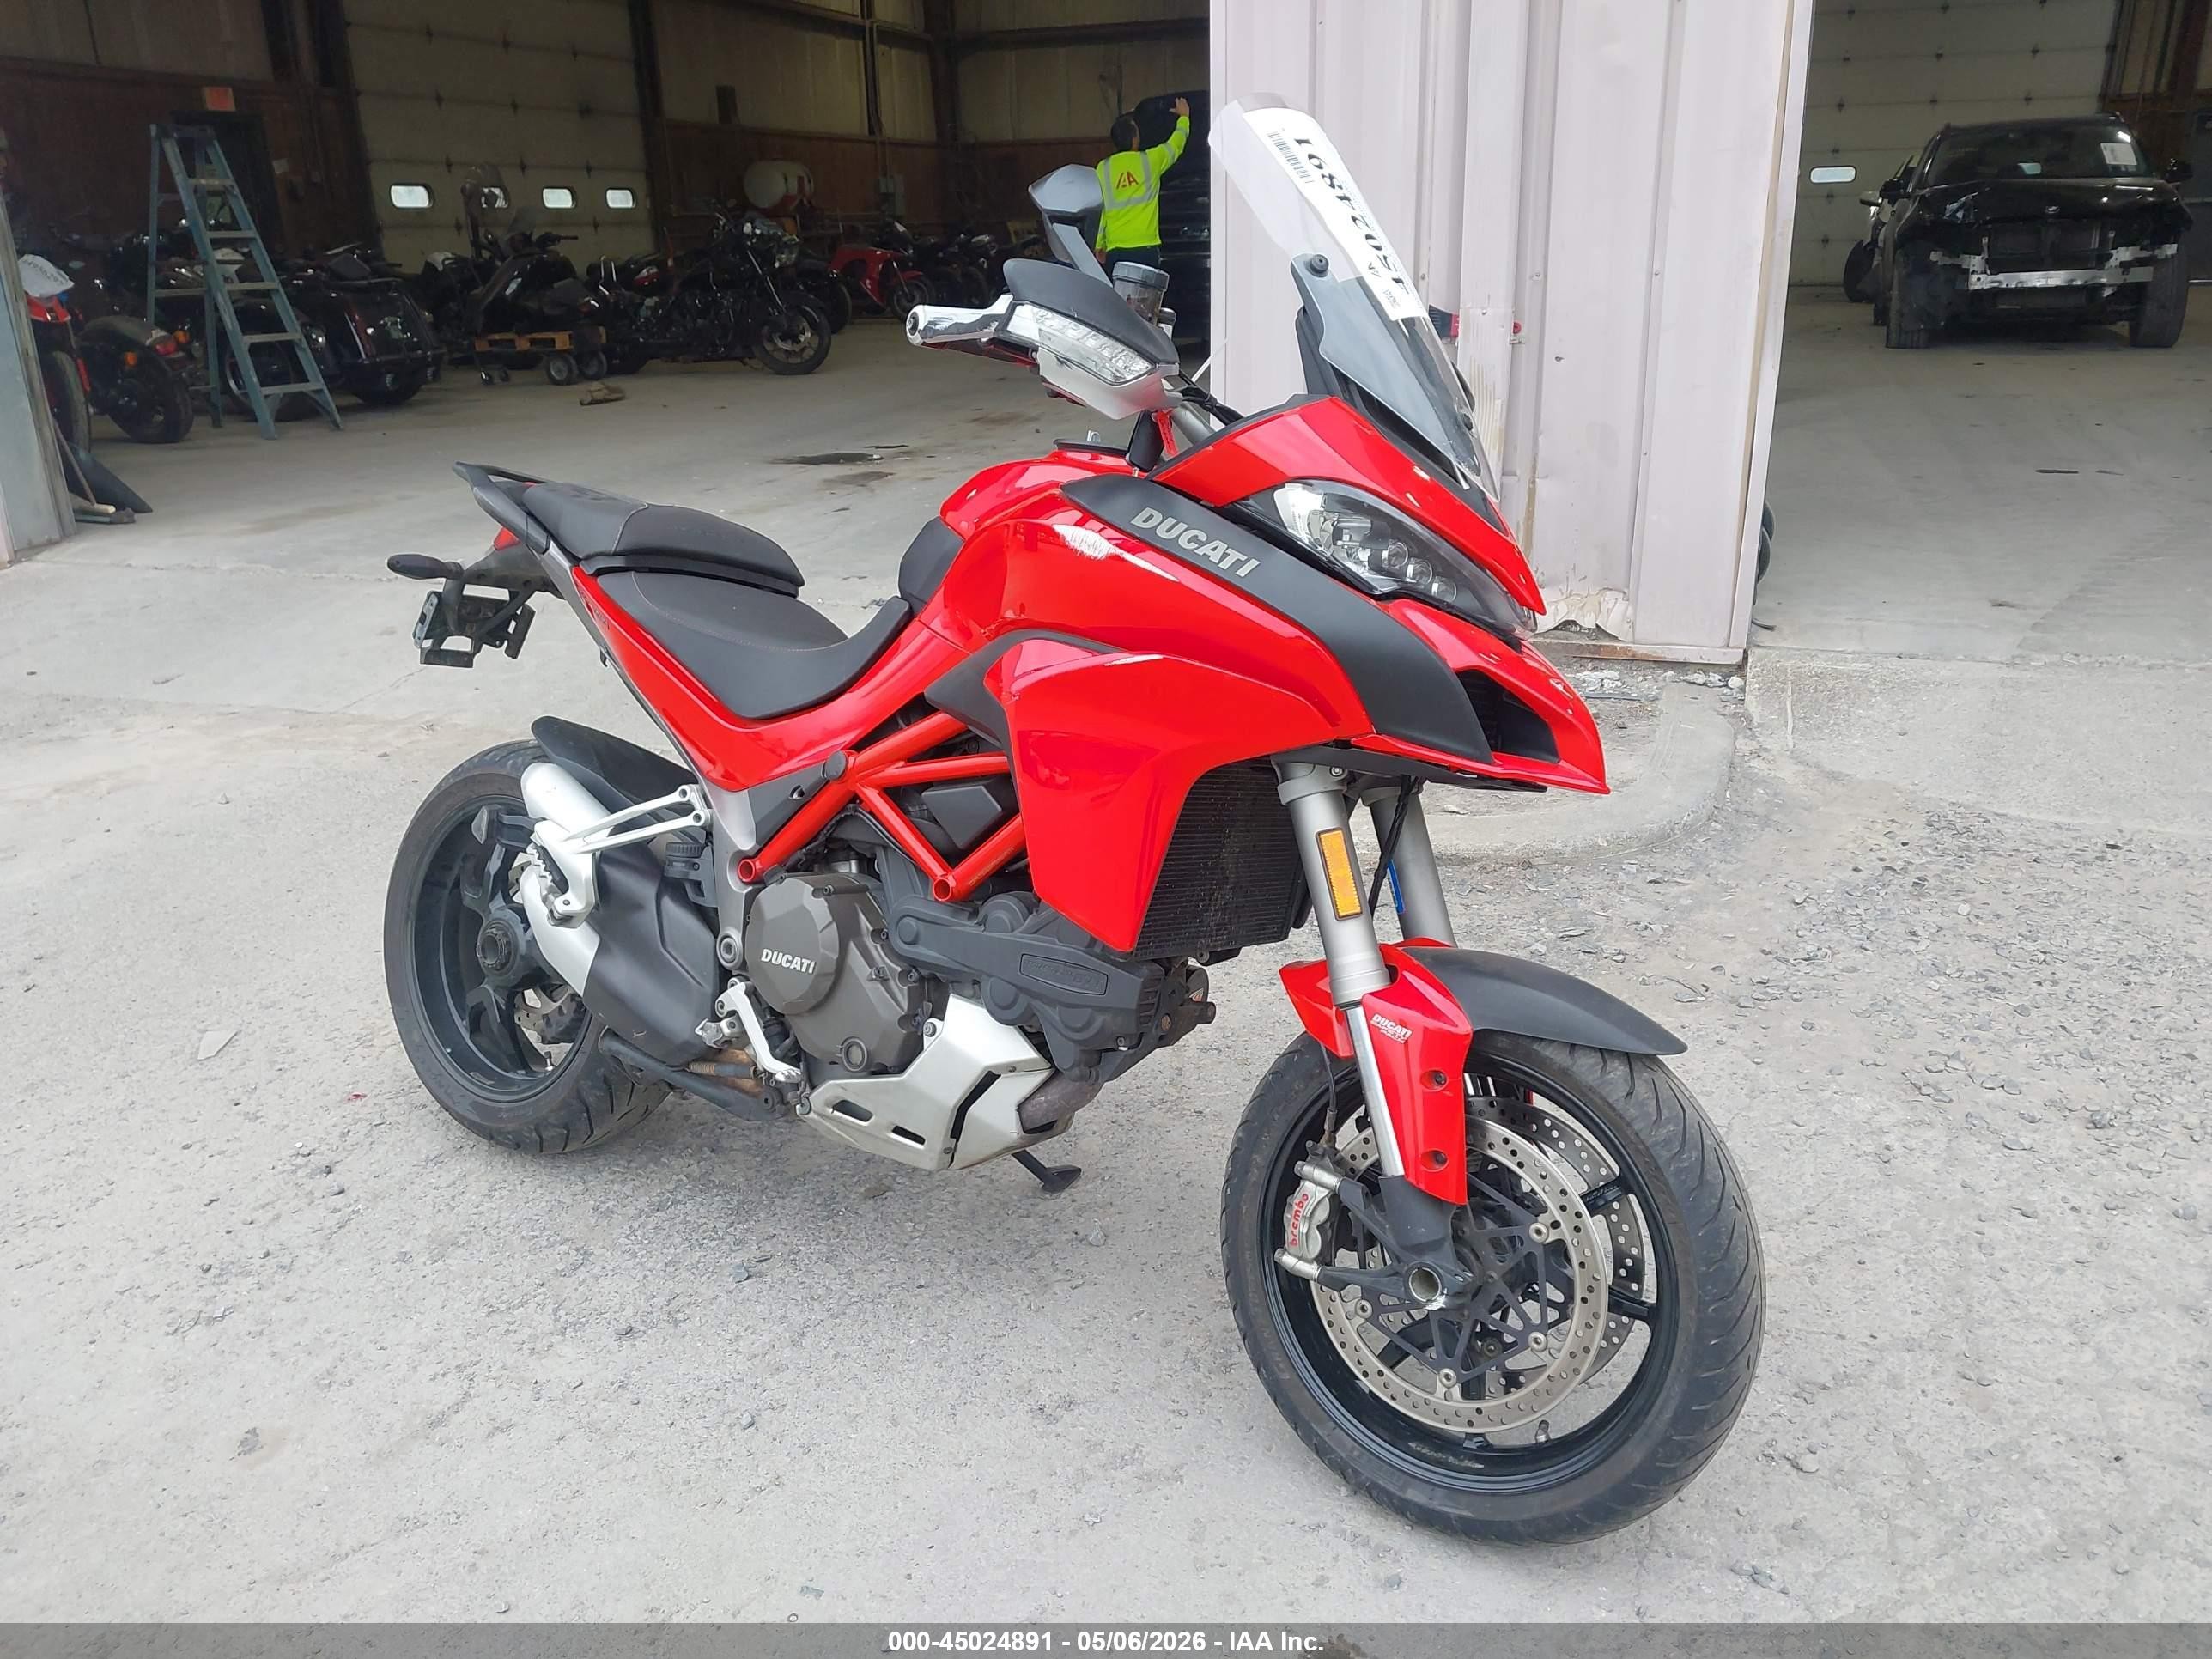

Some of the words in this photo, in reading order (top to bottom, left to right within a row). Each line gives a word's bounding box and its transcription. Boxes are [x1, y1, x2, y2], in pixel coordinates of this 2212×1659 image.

[1293, 137, 1410, 295] 45024891
[1130, 507, 1261, 578] DUCATI
[761, 948, 816, 974] DUCATI
[1372, 1013, 1413, 1038] DUCATI
[1289, 1193, 1309, 1247] brembo
